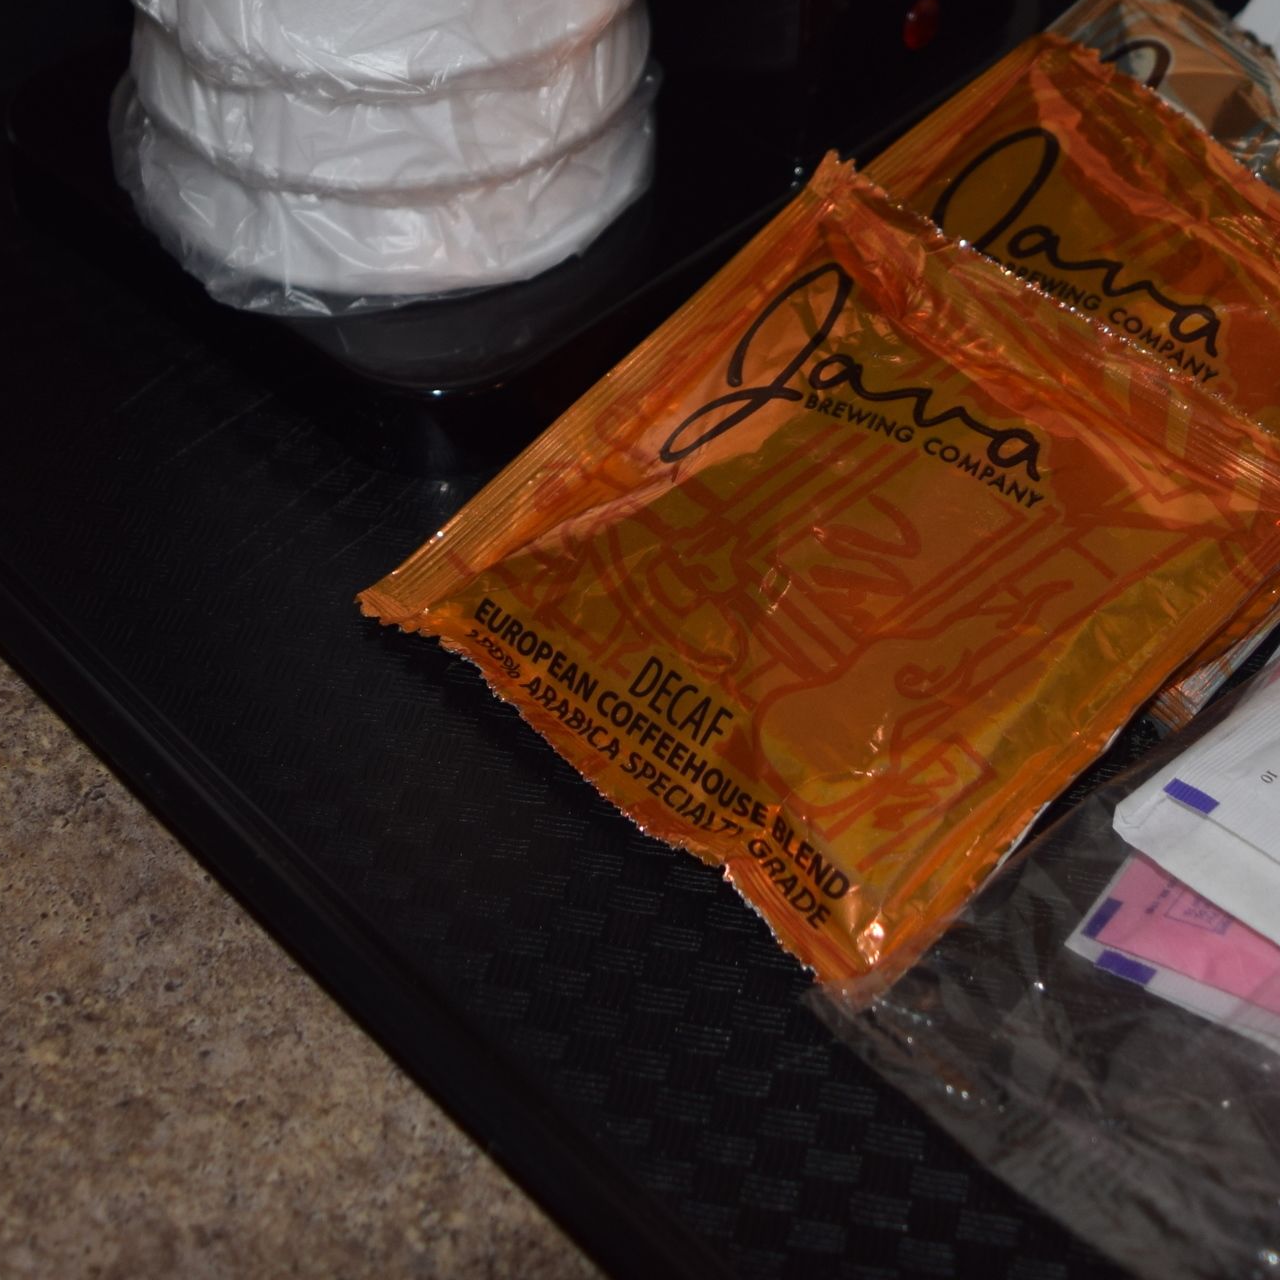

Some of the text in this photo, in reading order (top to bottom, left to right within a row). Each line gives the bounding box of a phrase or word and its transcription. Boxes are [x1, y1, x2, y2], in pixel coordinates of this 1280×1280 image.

[930, 126, 1221, 358] Java
[997, 257, 1218, 384] REWING COMPANY
[659, 262, 1042, 483] Java
[804, 390, 1045, 509] BREWING COMPANY
[474, 597, 850, 900] EUROPEAN COFFEEHOUSE BLEND
[520, 676, 620, 761] ARABICA
[748, 838, 832, 929] GRADE
[628, 655, 734, 748] DECAF
